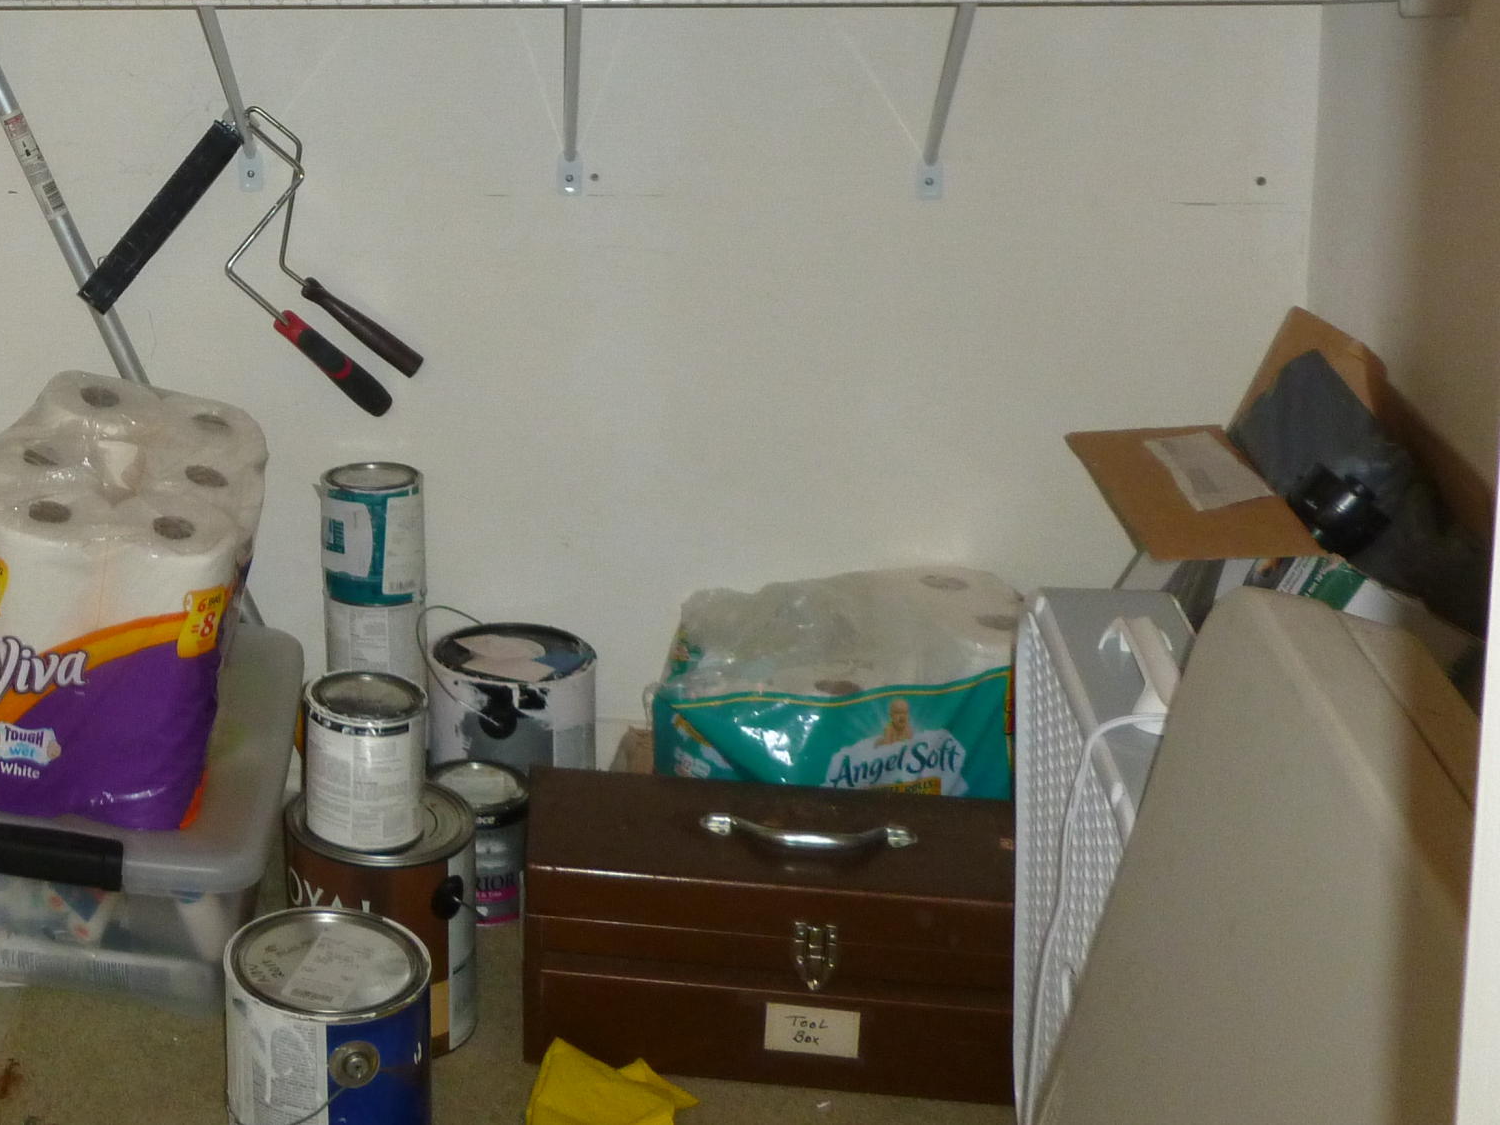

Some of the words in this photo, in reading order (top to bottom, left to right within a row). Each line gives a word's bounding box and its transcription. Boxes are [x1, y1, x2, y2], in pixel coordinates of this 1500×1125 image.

[197, 597, 208, 613] 6
[4, 725, 45, 748] TOUGH
[8, 745, 38, 759] wet
[0, 761, 41, 780] White
[829, 743, 904, 789] Angel
[906, 738, 961, 774] Soft
